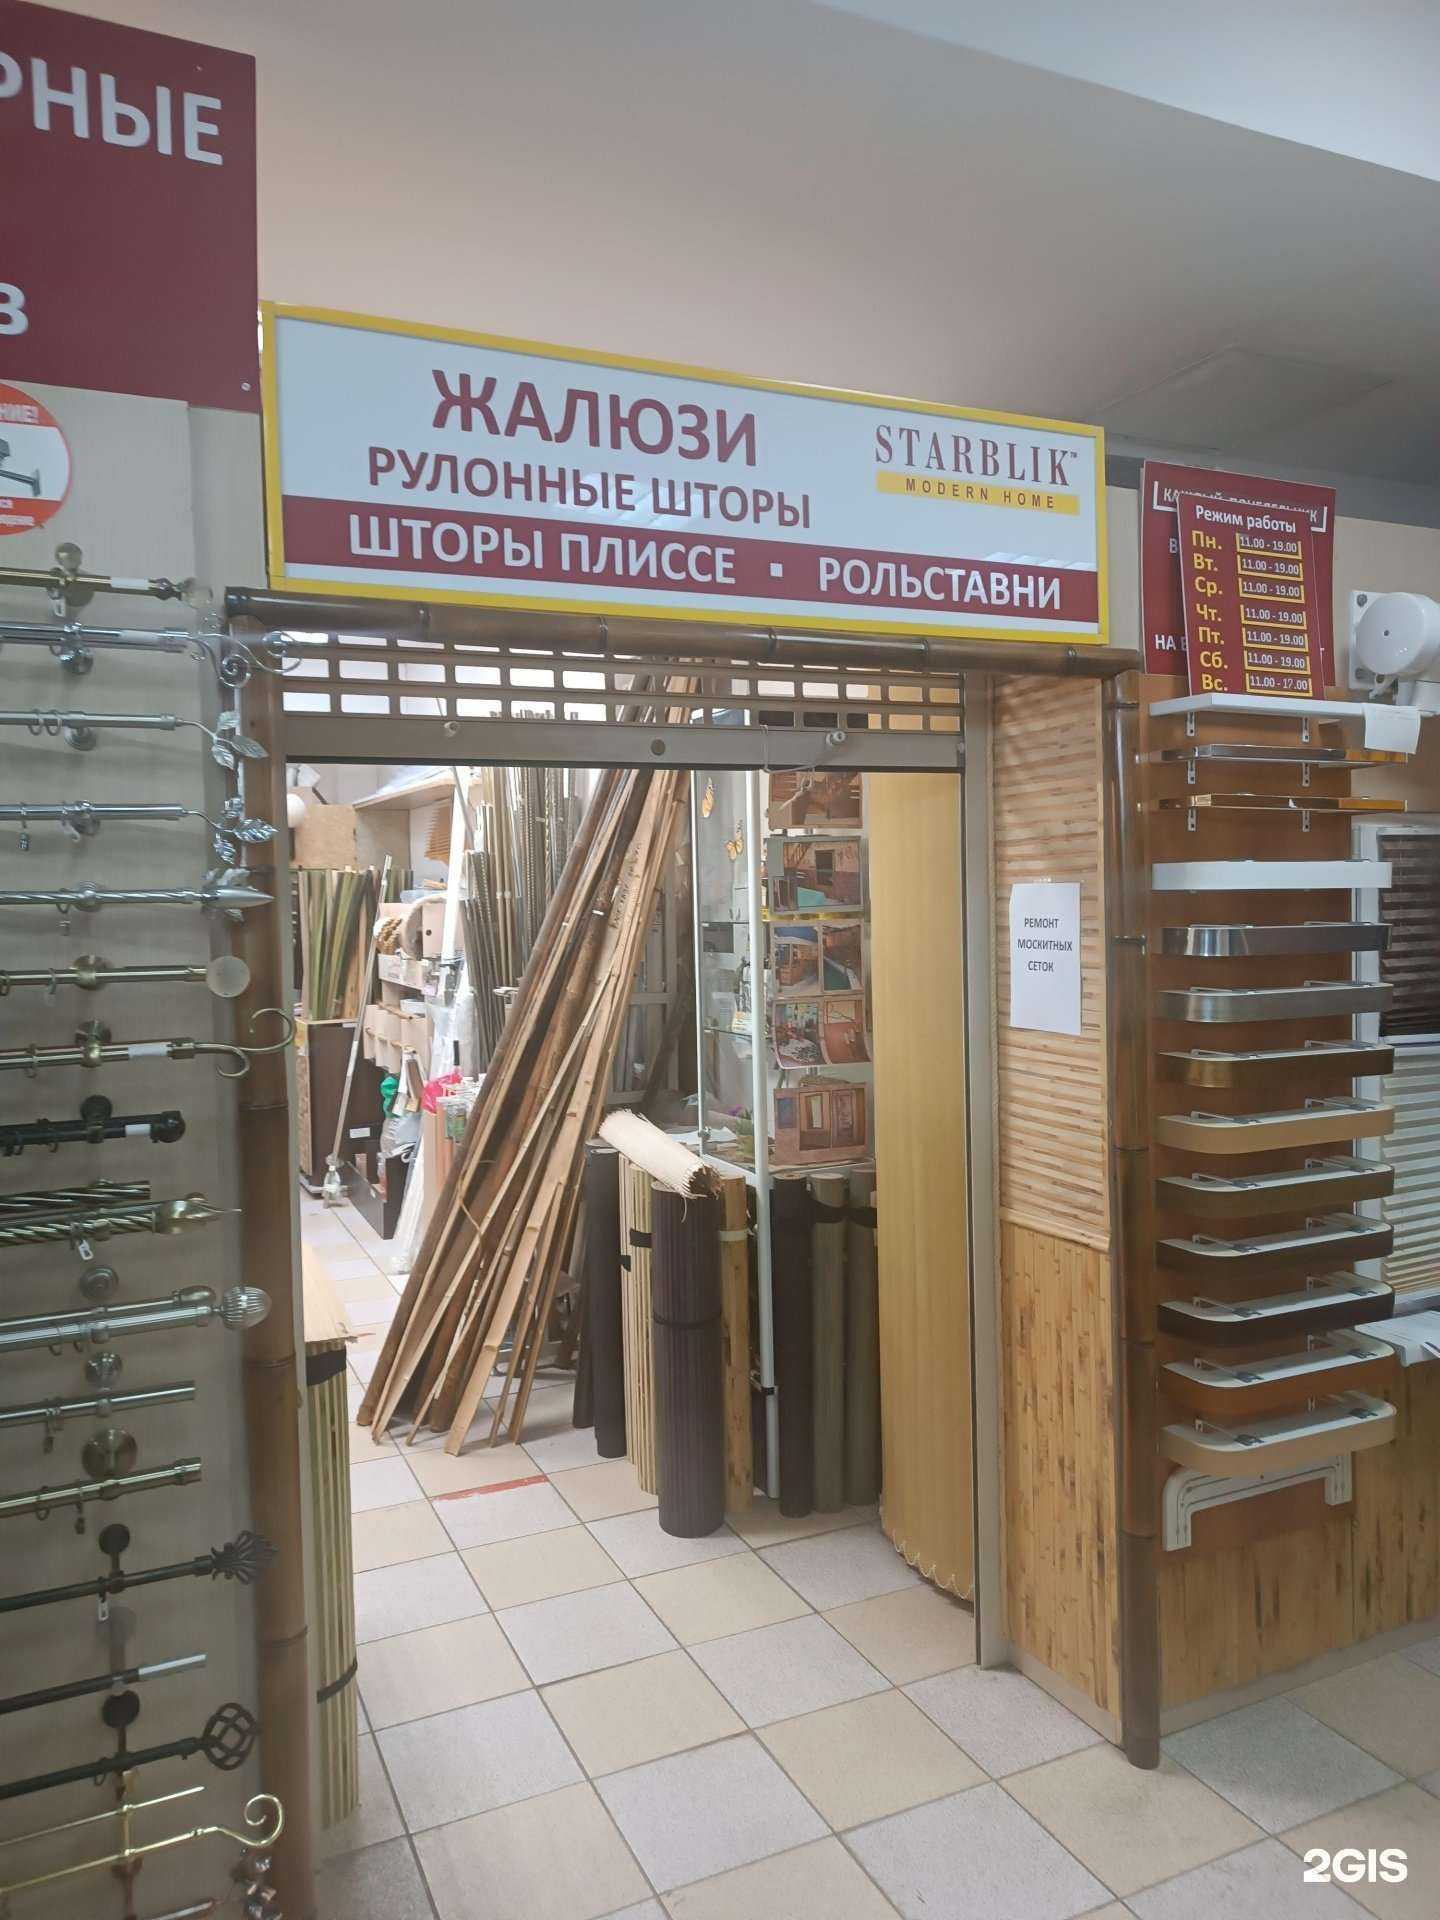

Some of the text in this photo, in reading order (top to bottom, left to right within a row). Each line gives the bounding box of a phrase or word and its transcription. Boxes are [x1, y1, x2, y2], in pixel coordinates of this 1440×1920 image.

[432, 369, 756, 467] ЖАЛЮЗИ
[368, 446, 811, 529] РУЛОННЫЕ ШТОРЫ
[906, 478, 1054, 509] MODERN HOME
[1195, 505, 1243, 526] Режим
[1247, 515, 1296, 533] работы
[1192, 530, 1223, 550] Пн.
[349, 514, 1061, 610] ШТОРЫ ПЛИССЕ РОЛЬСТАВНИ
[1193, 553, 1219, 572] Вт.
[1194, 576, 1223, 597] Ср.
[1196, 603, 1222, 622] Чт.
[1155, 634, 1177, 650] НА
[1198, 627, 1225, 645] Пт.
[1200, 651, 1229, 669] Сб.
[1201, 673, 1229, 692] Вс.
[1024, 917, 1059, 929] РЕМОНТ
[1017, 939, 1073, 951] МОСКИТНЫХ
[1028, 960, 1054, 972] СЕТОК
